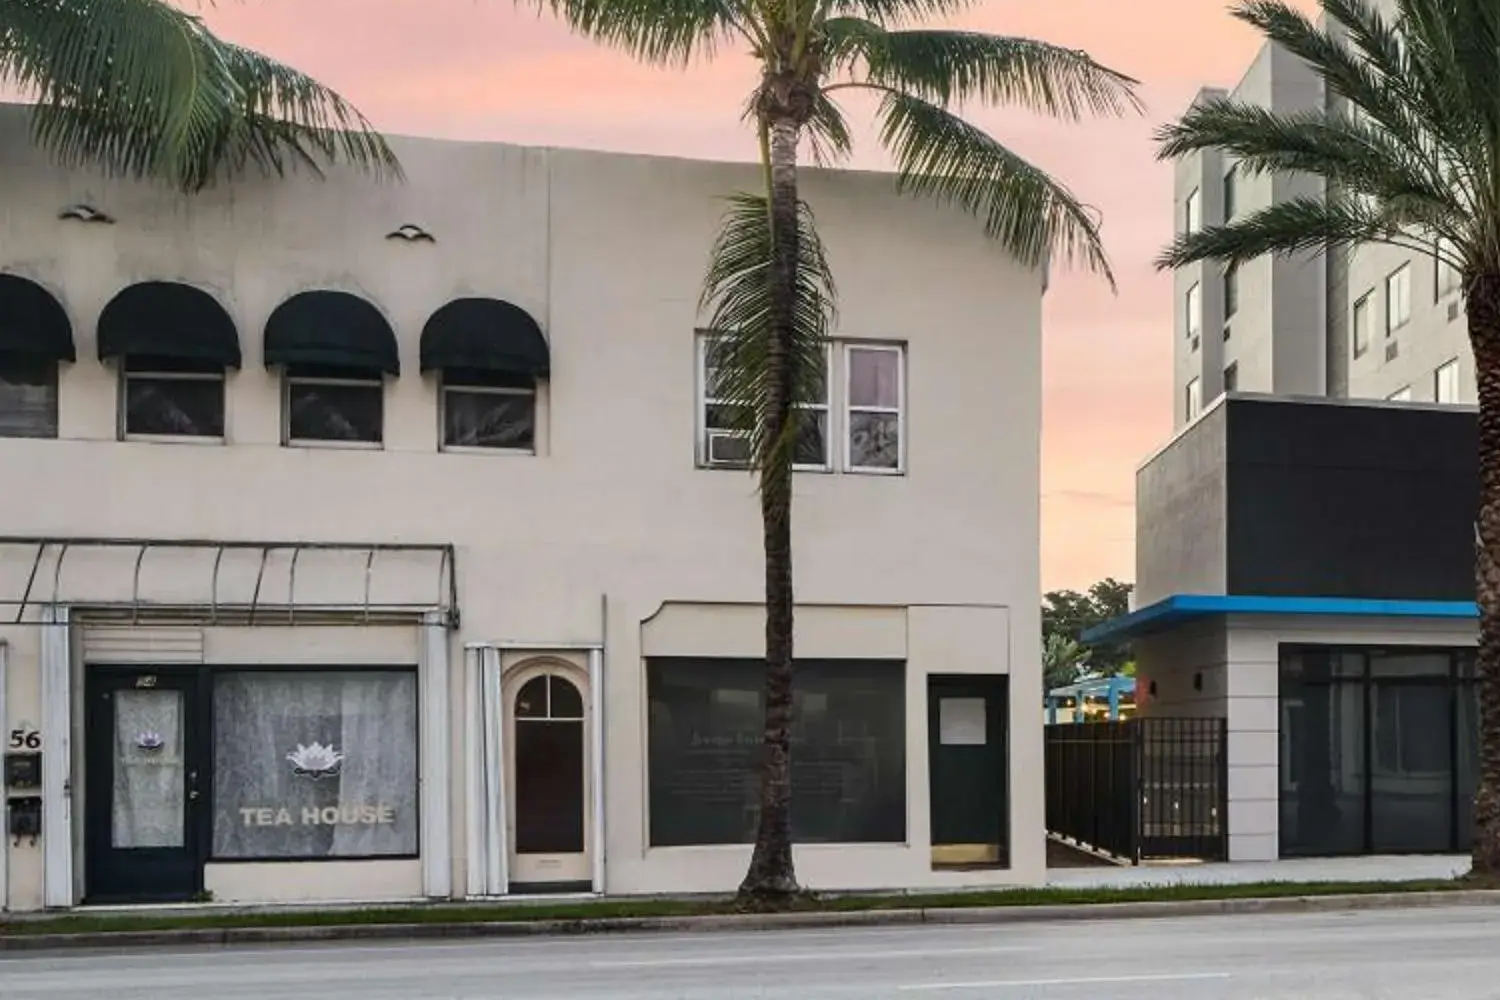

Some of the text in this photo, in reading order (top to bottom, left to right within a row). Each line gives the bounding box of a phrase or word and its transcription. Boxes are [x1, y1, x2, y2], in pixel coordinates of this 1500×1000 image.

[9, 729, 41, 749] 56
[239, 806, 395, 827] TEA HOUSE
